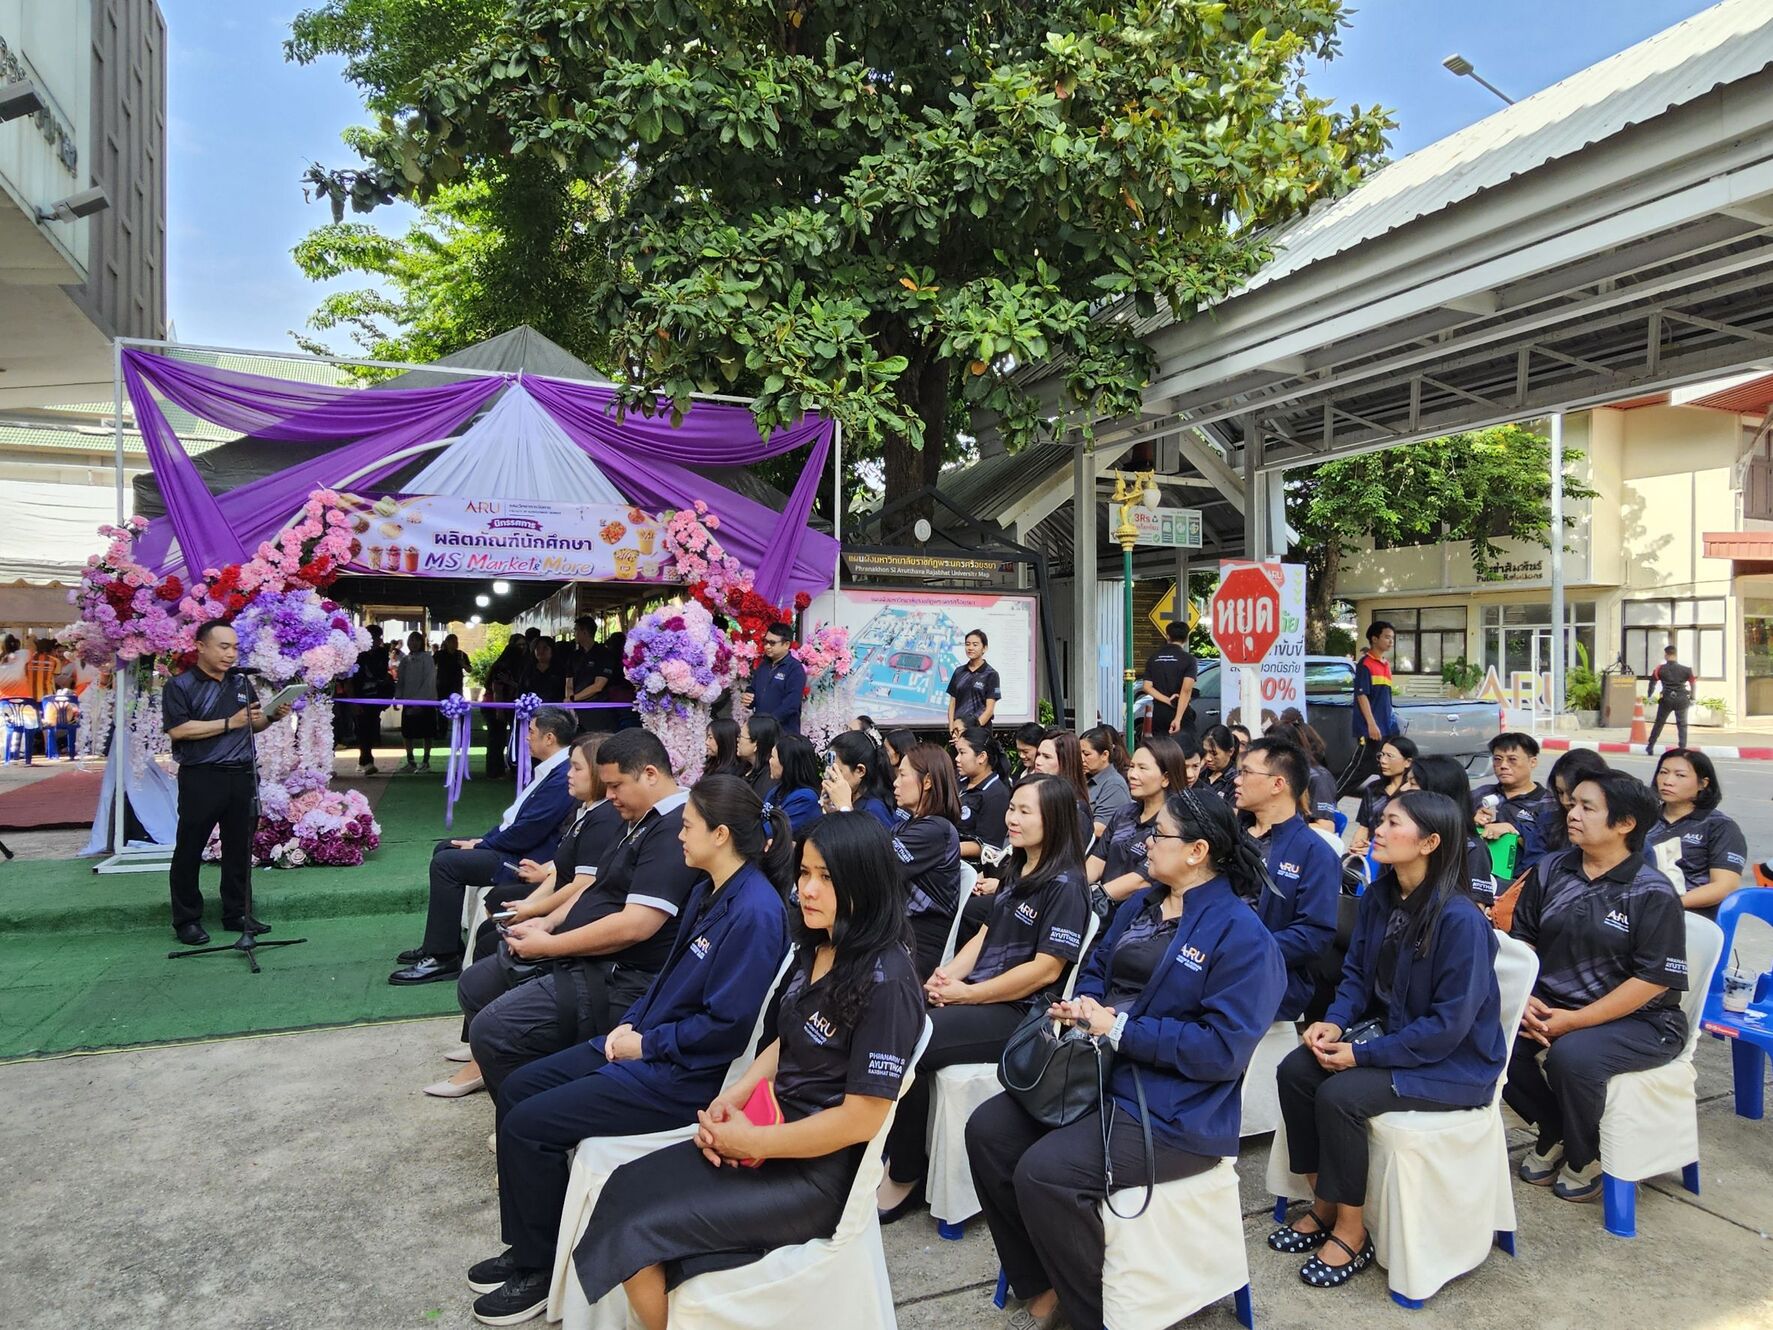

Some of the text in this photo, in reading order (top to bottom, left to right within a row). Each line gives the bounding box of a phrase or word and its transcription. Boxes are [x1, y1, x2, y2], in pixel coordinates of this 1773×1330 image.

[465, 501, 500, 513] ARU
[434, 531, 593, 551] ผลิตภัณฑ์นักศึกษา
[425, 552, 462, 569] MS
[467, 553, 536, 573] Market
[543, 557, 592, 574] More
[1216, 597, 1273, 651] หยุด
[1017, 902, 1038, 919] ARU
[1181, 942, 1206, 963] ARU
[808, 1010, 837, 1038] ARU
